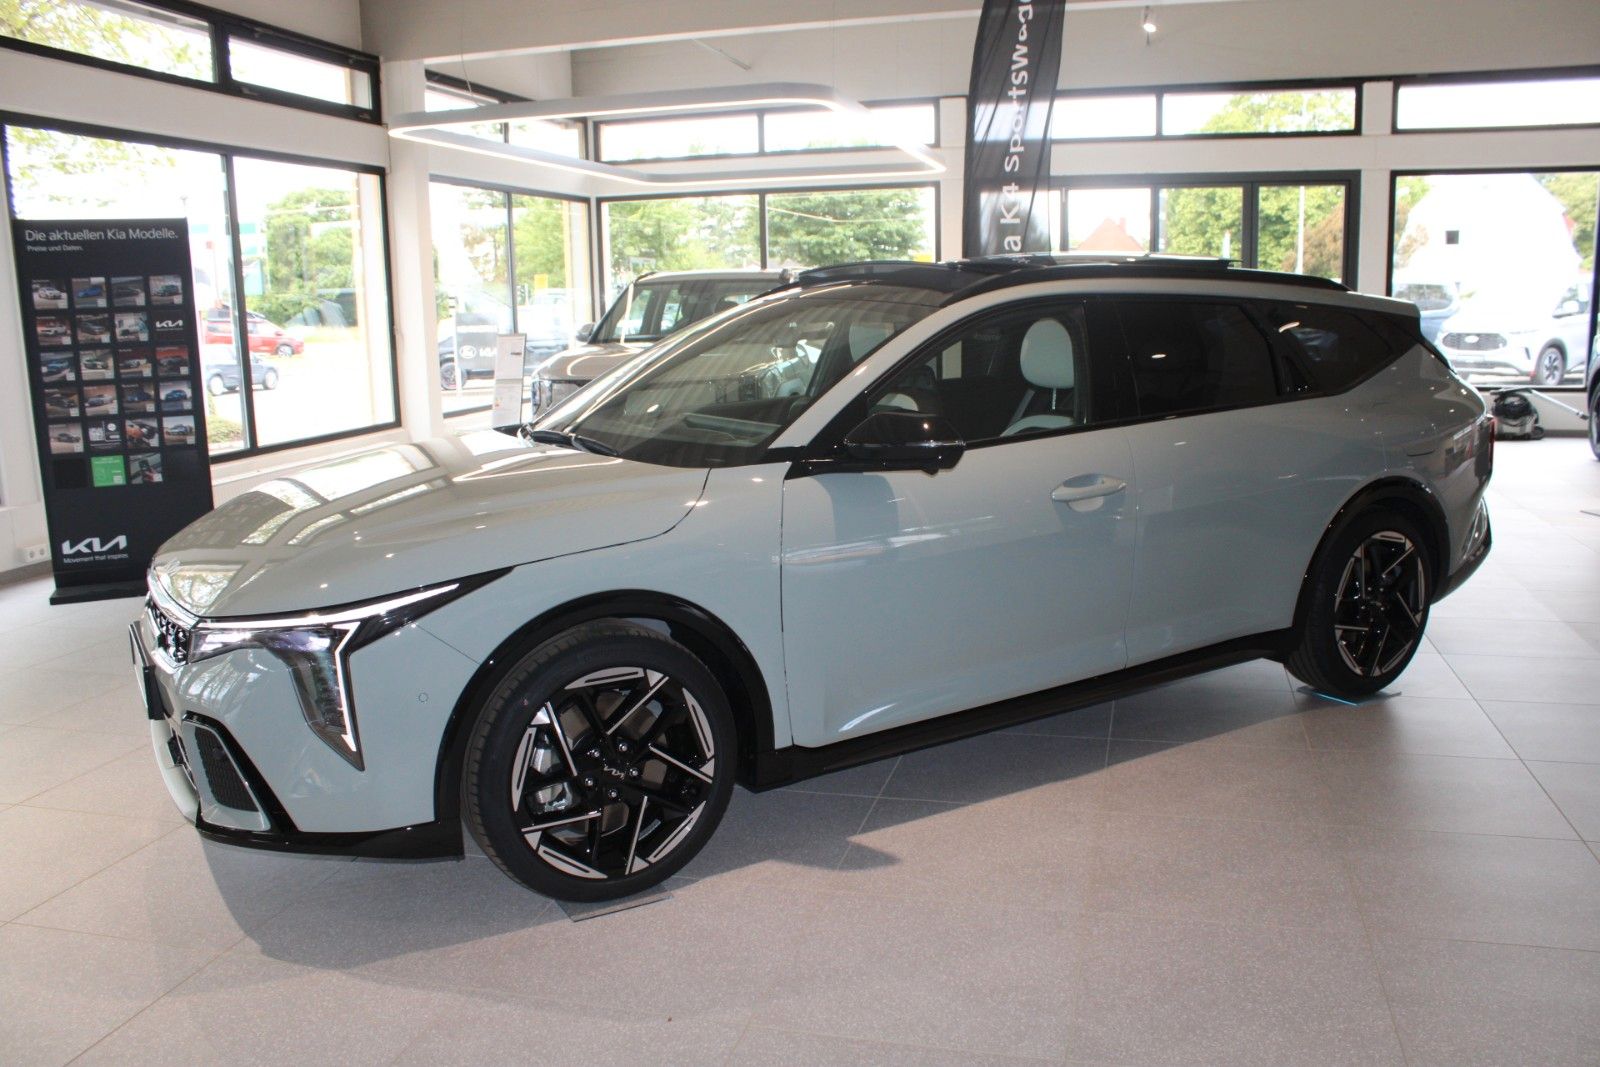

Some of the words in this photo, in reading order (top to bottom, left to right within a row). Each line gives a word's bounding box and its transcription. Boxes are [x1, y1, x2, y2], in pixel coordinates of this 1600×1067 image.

[1004, 0, 1034, 173] Sportswag
[999, 182, 1021, 224] K4
[25, 229, 46, 242] Die
[49, 228, 105, 242] aktuellen
[107, 228, 127, 241] Kia
[129, 227, 179, 240] Modelle.
[155, 320, 184, 328] KIA
[62, 535, 128, 555] KIA
[63, 556, 93, 564] Movement
